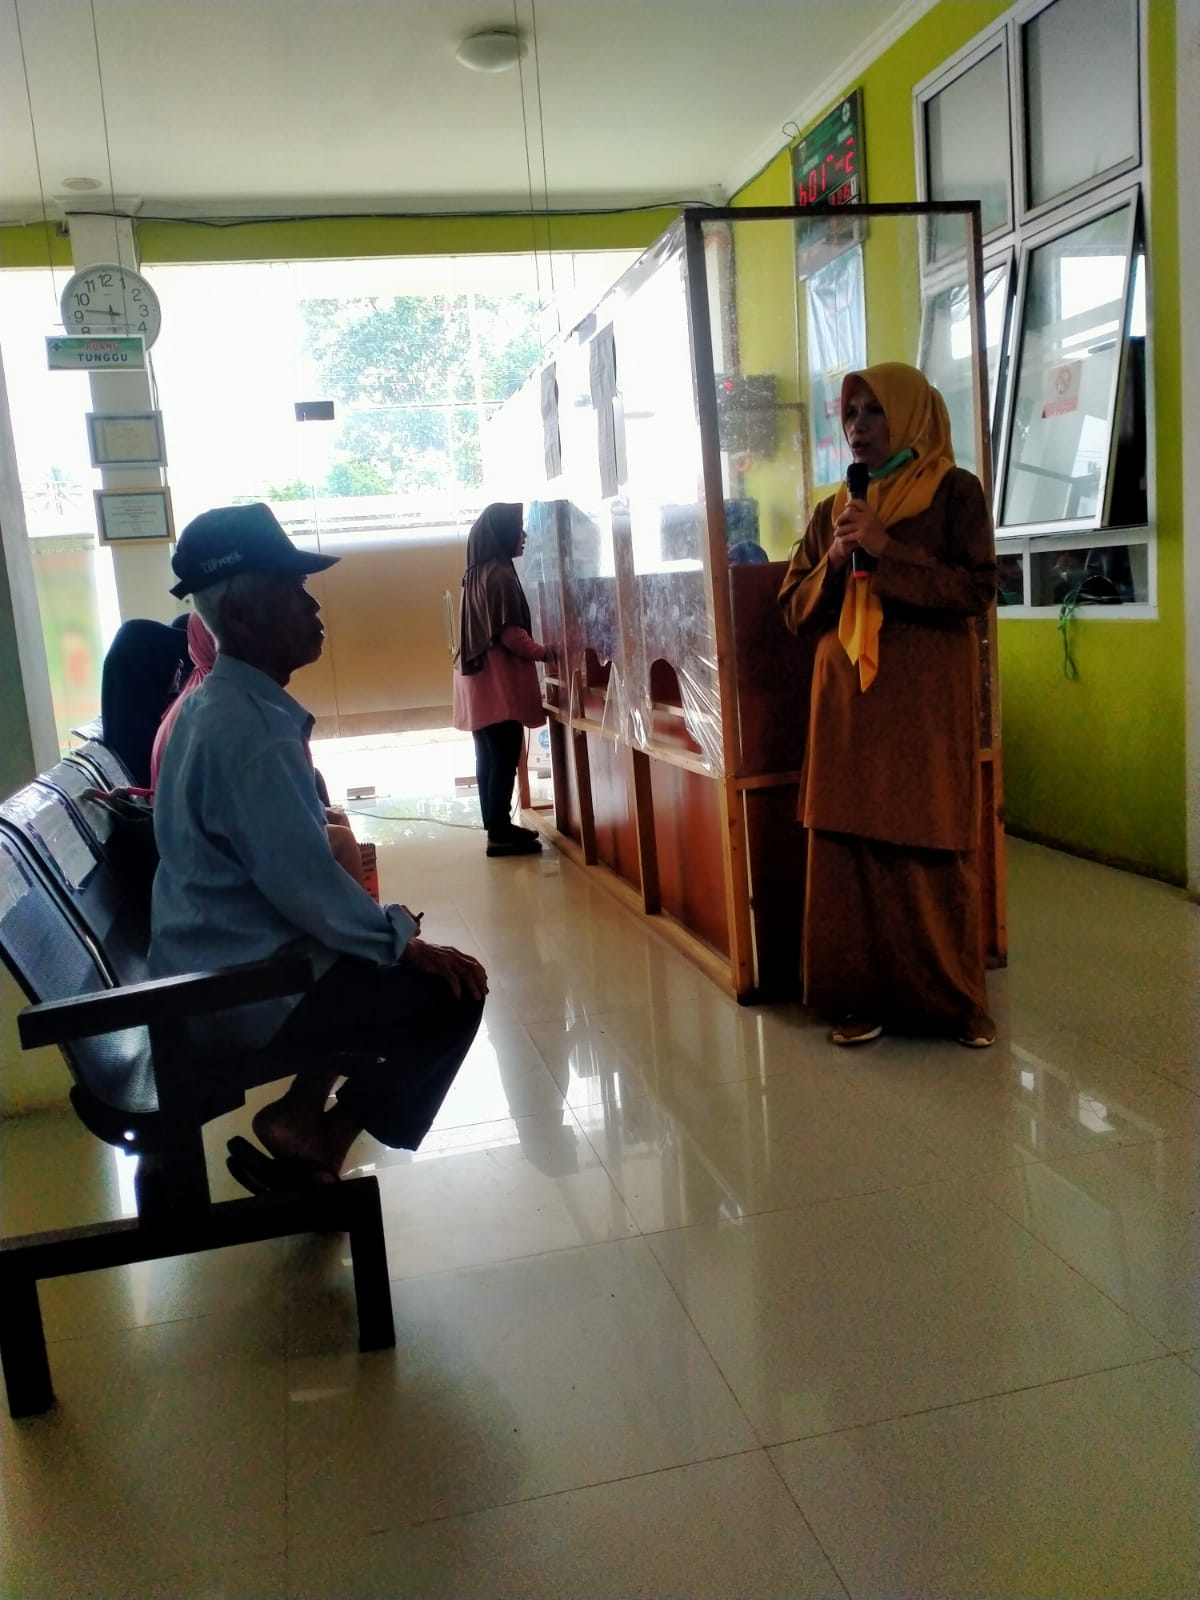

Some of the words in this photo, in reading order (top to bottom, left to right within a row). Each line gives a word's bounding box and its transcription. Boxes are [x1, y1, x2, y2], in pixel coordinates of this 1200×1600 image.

[84, 279, 96, 293] 11
[97, 274, 113, 288] 12
[74, 293, 90, 307] 10
[131, 288, 142, 302] 2
[73, 310, 84, 323] 9
[138, 304, 150, 318] 3
[137, 321, 148, 334] 4
[77, 353, 128, 362] TUNGGU
